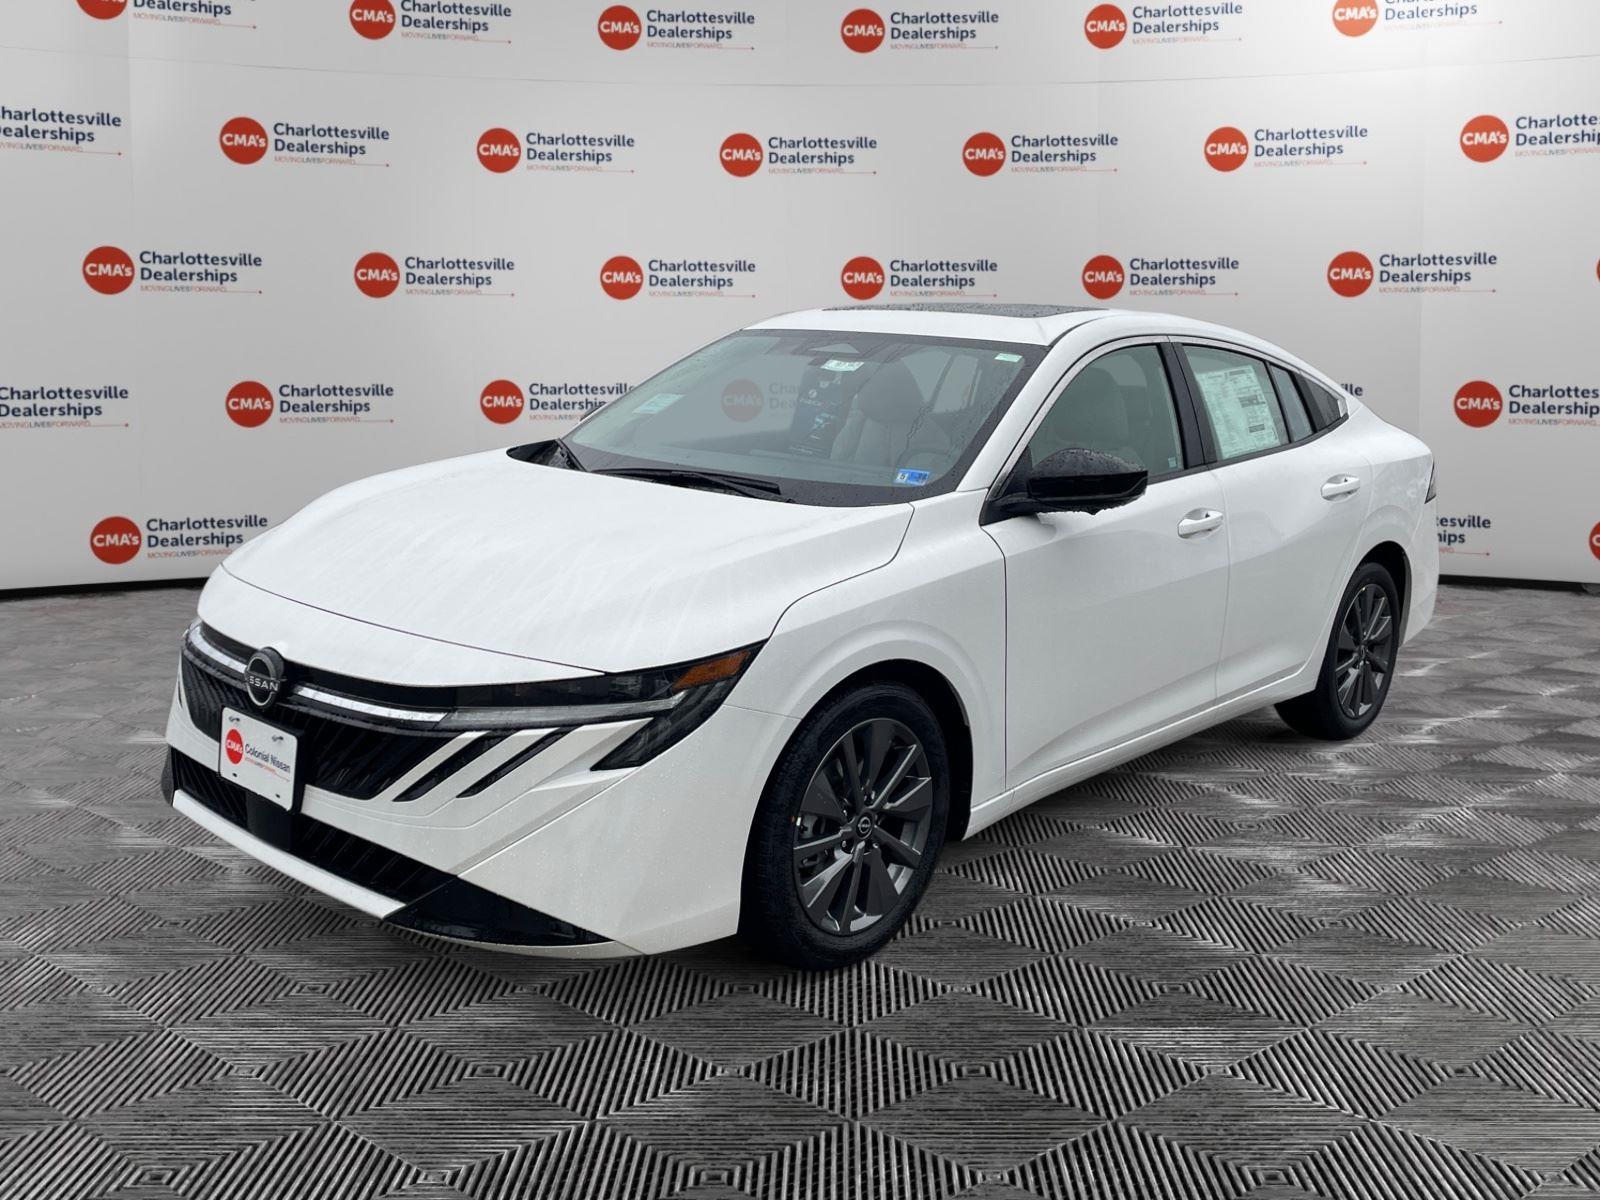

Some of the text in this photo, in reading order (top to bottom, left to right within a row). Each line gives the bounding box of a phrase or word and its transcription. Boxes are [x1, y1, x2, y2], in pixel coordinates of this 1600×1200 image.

[134, 0, 232, 17] Dealerships
[400, 0, 512, 17] Charlottesville
[1132, 2, 1243, 18] Charlottesville
[1334, 7, 1377, 21] CMA's
[1385, 2, 1478, 20] Dealerships
[352, 9, 394, 24] CMA's
[646, 10, 755, 25] Charlottesville
[890, 11, 999, 25] Charlottesville
[401, 15, 489, 33] Dealerships
[600, 21, 640, 34] CMA's
[843, 24, 883, 37] CMA's
[1086, 19, 1126, 32] CMA's
[1133, 20, 1219, 34] Dealerships
[647, 26, 733, 41] Dealerships
[890, 26, 977, 41] Dealerships
[0, 106, 122, 126] harlottesville
[1515, 114, 1600, 129] Charlotte
[0, 125, 95, 145] ealerships
[273, 123, 389, 140] Charlottesville
[1254, 125, 1368, 141] Charlottesville
[1462, 131, 1507, 145] CMA's
[222, 133, 266, 147] CMA's
[526, 133, 634, 147] Charlottesville
[768, 136, 877, 149] Charlottesville
[1011, 134, 1118, 148] Charlottesville
[274, 139, 366, 157] Dealerships
[479, 143, 519, 157] CMA's
[722, 149, 761, 161] CMA's
[965, 148, 1005, 160] CMA's
[1206, 143, 1247, 156] CMA's
[1255, 143, 1344, 158] Dealerships
[526, 148, 612, 164] Dealerships
[768, 152, 854, 167] Dealerships
[1012, 150, 1096, 164] Dealerships
[139, 251, 263, 266] Charlottesville
[405, 256, 515, 270] Charlottesville
[648, 259, 756, 272] Charlottesville
[890, 259, 998, 272] Charlottesville
[1129, 257, 1239, 271] Charlottesville
[1379, 252, 1497, 267] Charlottesville
[85, 263, 132, 277] CMA's
[140, 267, 238, 285] Dealerships
[356, 269, 398, 281] CMA's
[1084, 271, 1123, 283] CMA's
[1330, 267, 1372, 280] CMA's
[1379, 269, 1472, 285] Dealerships
[405, 272, 492, 288] Dealerships
[602, 272, 642, 284] CMA's
[649, 274, 734, 290] Dealerships
[843, 272, 883, 284] CMA's
[890, 275, 975, 289] Dealerships
[1130, 273, 1216, 288] Dealerships
[0, 386, 129, 400] Charlottesville
[278, 384, 394, 397] Charlottesville
[1508, 384, 1600, 399] Charlottes
[228, 398, 272, 410] CMA's
[279, 400, 371, 415] Dealerships
[482, 395, 522, 408] CMA's
[1456, 397, 1501, 410] CMA's
[0, 402, 103, 419] Dealerships
[1508, 401, 1600, 418] Dealership
[146, 514, 268, 532] Charlottesville
[93, 533, 139, 547] CMA's
[147, 532, 244, 548] Dealerships
[245, 743, 270, 763] Colonial
[270, 754, 291, 774] Nissan
